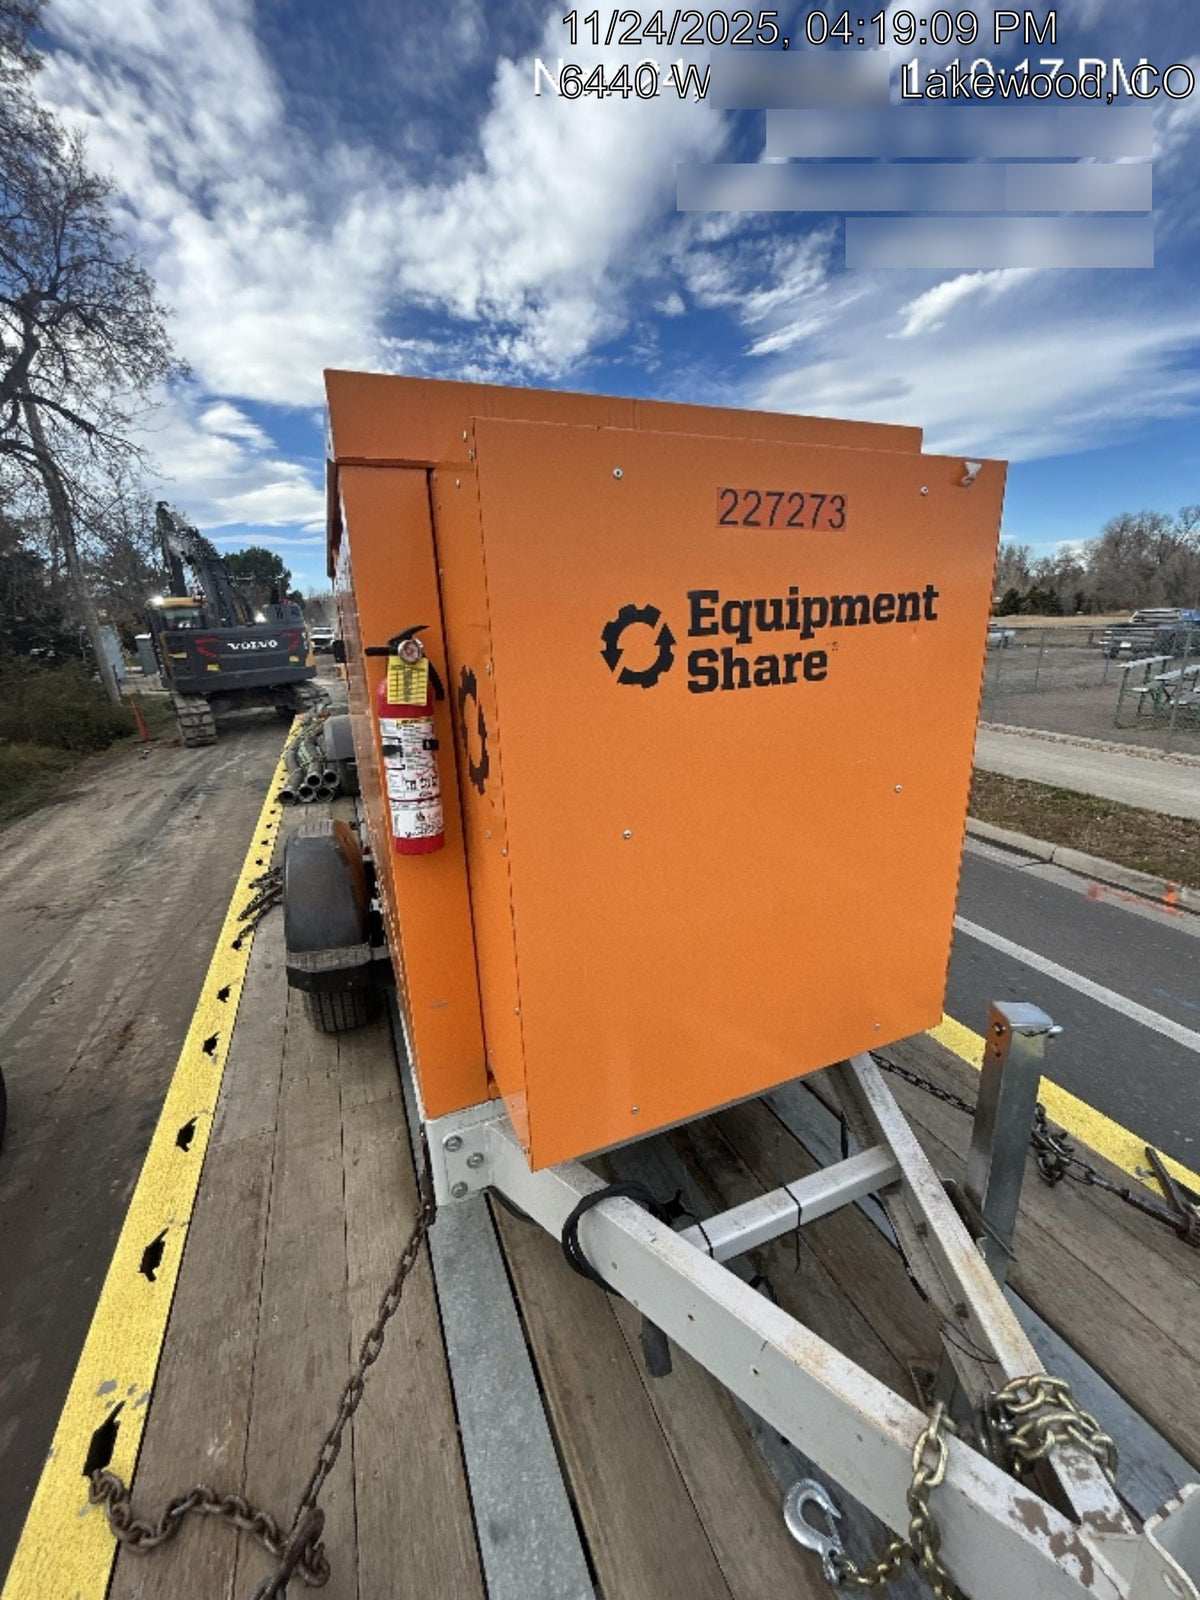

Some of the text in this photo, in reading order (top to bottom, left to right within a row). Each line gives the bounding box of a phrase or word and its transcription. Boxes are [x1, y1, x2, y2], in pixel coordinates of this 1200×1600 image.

[719, 488, 845, 529] 227273
[687, 584, 939, 644] Equipment
[227, 640, 278, 650] VOLVO
[687, 647, 828, 694] Share
